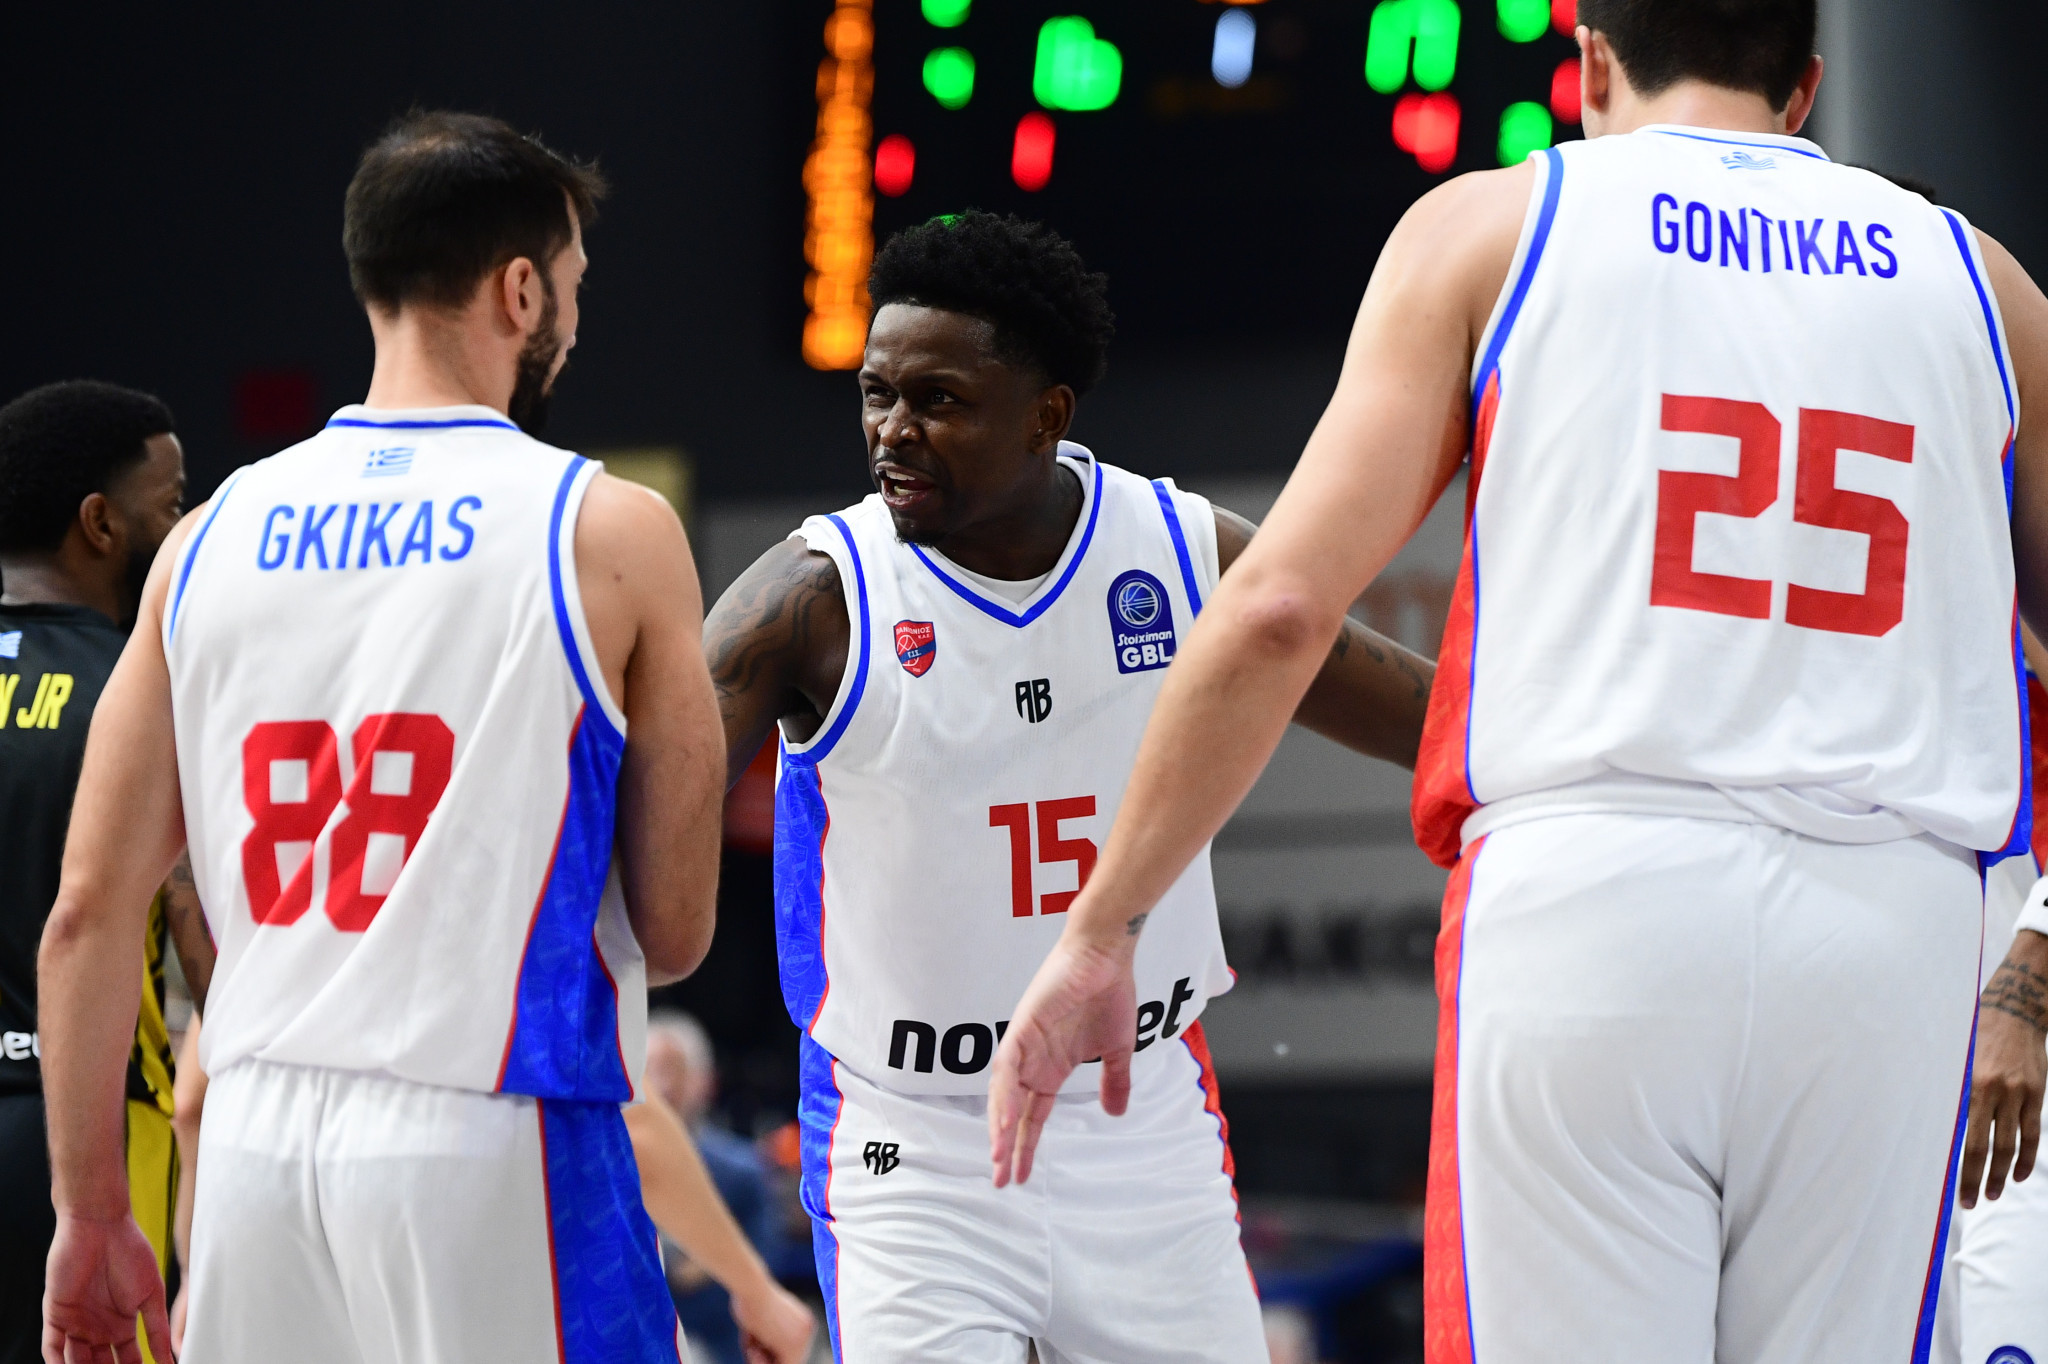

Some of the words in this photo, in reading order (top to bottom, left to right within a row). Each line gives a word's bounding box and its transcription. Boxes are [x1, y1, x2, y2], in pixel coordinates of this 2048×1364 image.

[1652, 192, 1898, 279] GONTIKAS
[257, 495, 483, 571] GKIKAS
[1650, 393, 1915, 637] 25
[1117, 630, 1173, 647] Stoiximan
[1122, 642, 1173, 668] GBL
[16, 673, 74, 729] JR
[242, 712, 455, 932] 88
[989, 795, 1098, 918] 15
